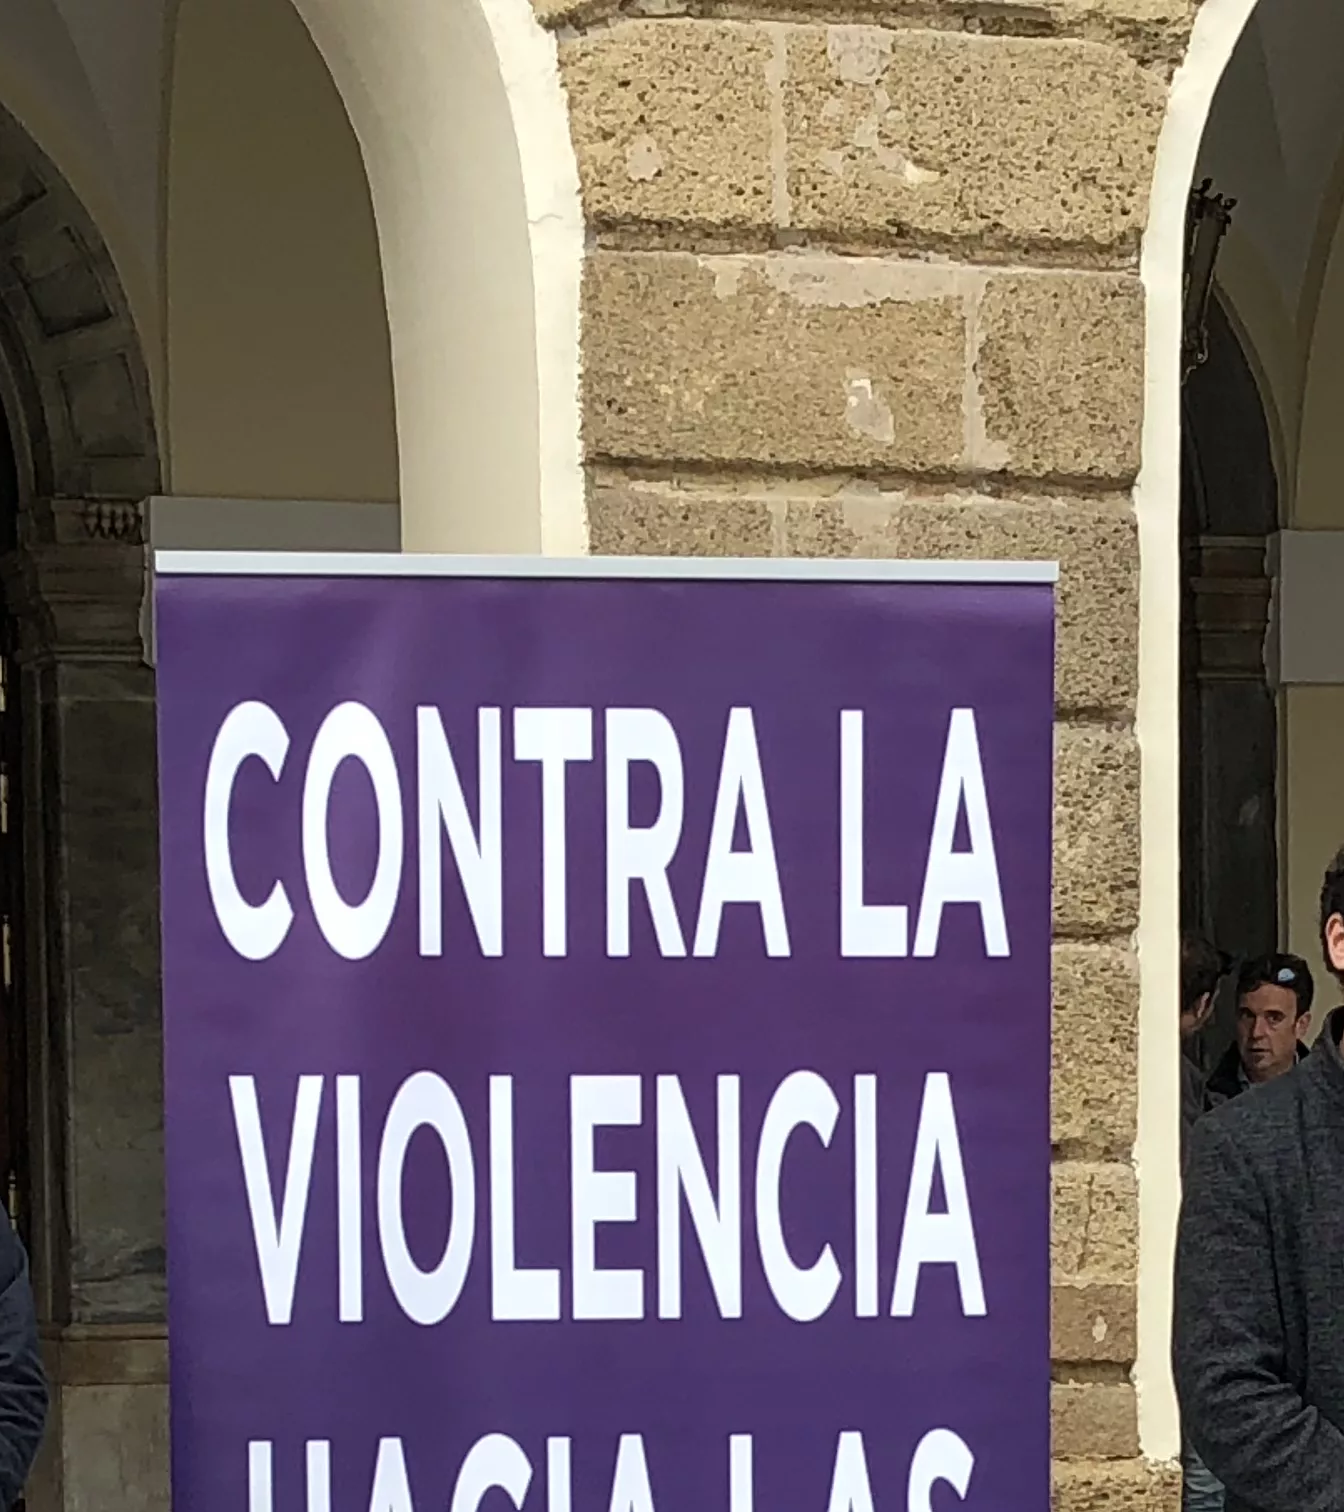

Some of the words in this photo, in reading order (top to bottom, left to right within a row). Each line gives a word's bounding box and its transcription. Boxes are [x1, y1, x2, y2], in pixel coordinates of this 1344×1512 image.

[204, 699, 791, 960] CONTRA
[840, 707, 1010, 957] LA
[228, 1070, 988, 1325] VIOLENCIA
